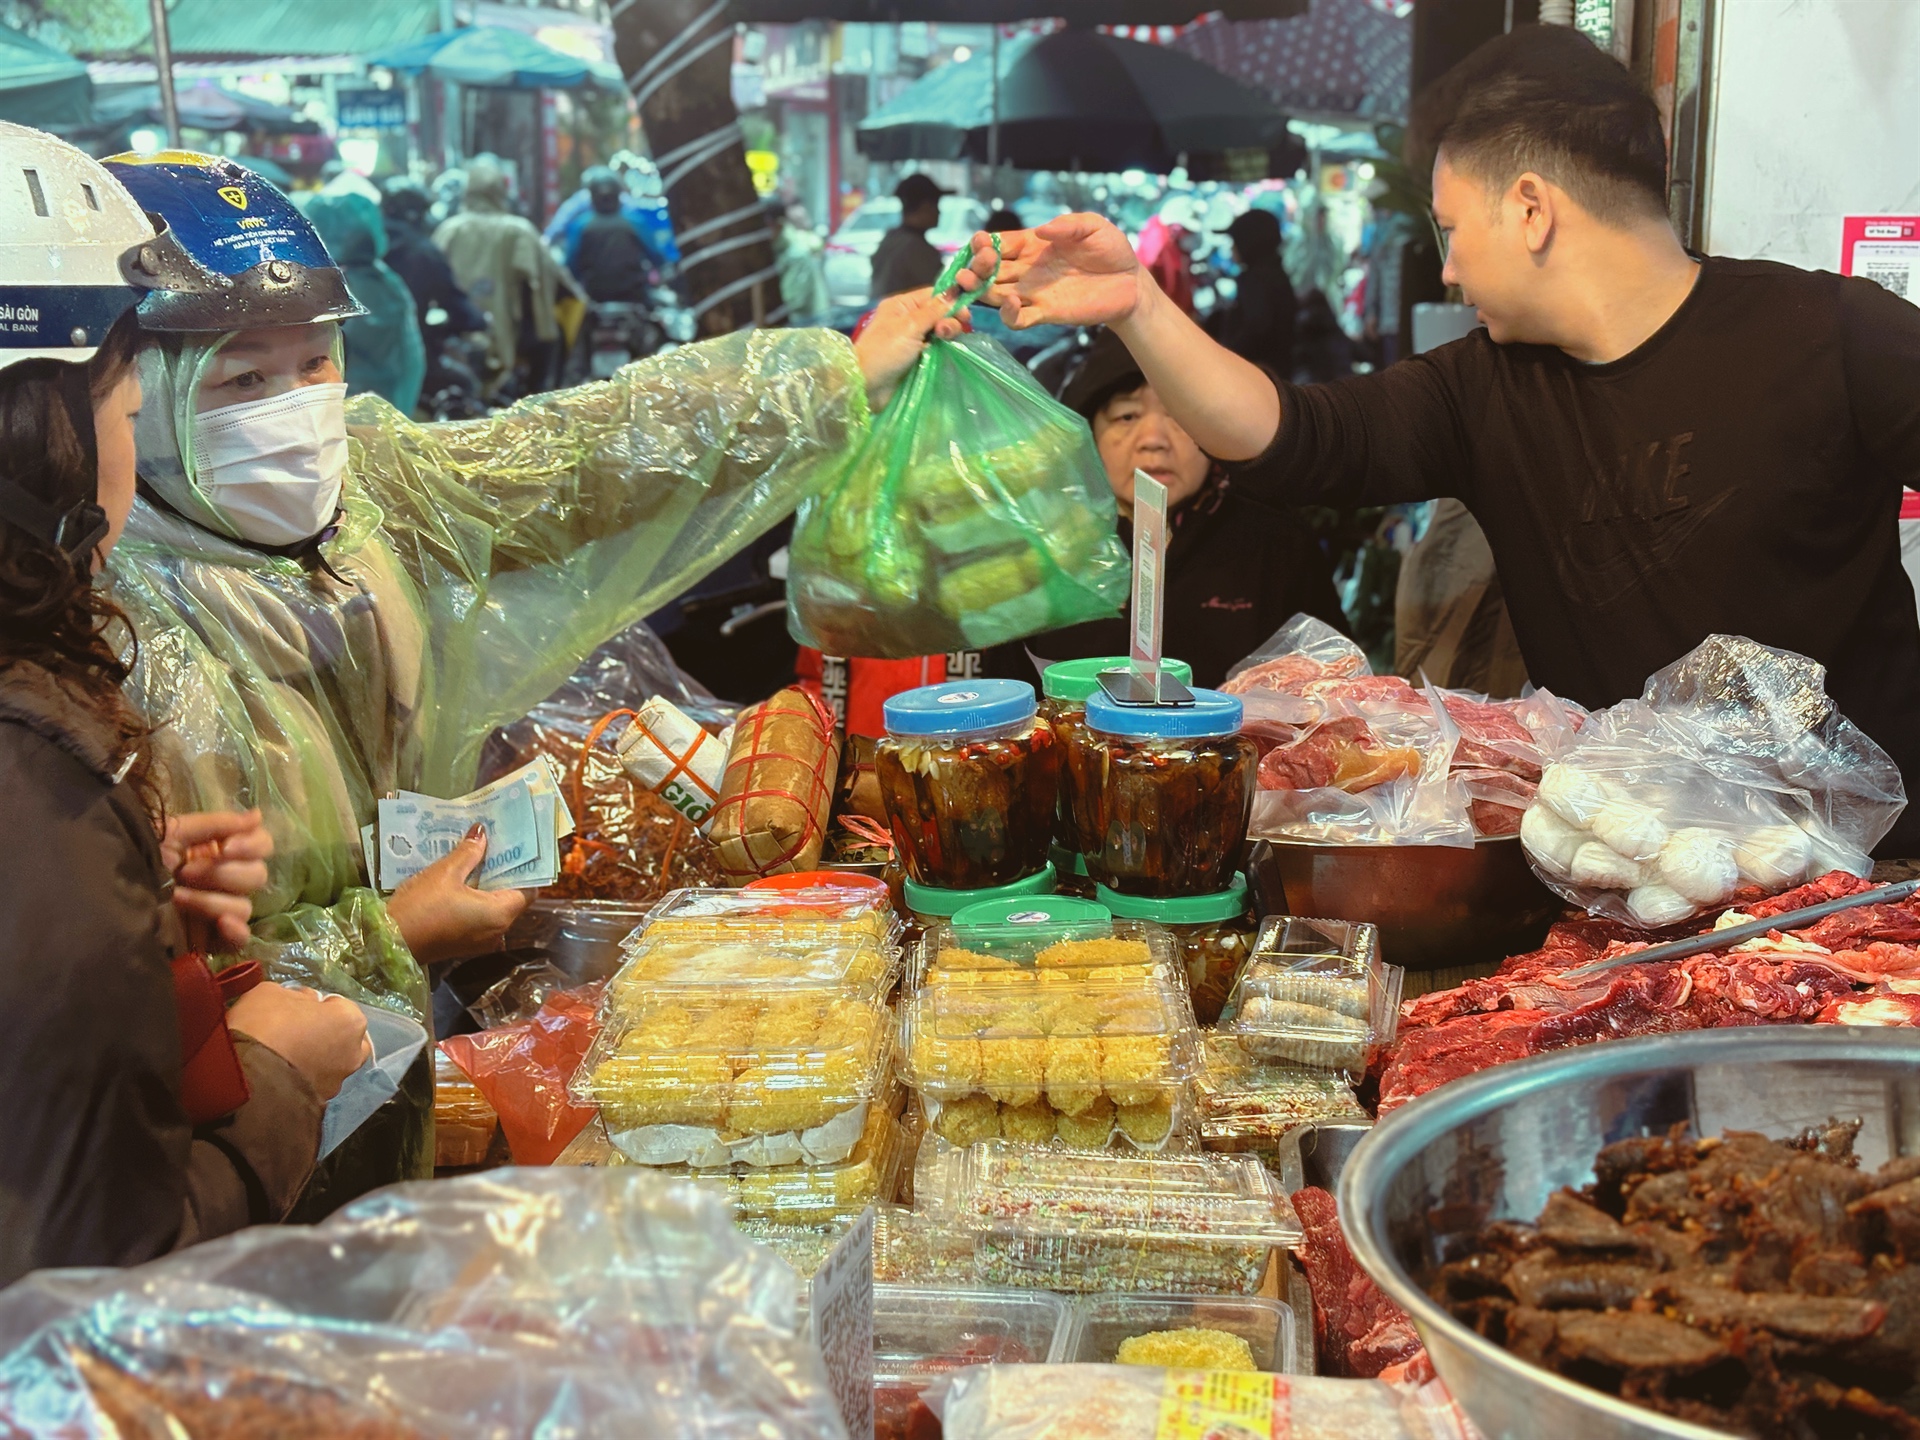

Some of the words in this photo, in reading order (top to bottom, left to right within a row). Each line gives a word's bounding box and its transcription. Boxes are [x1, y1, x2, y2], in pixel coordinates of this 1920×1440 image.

[236, 217, 268, 230] VNVC
[0, 303, 15, 320] SÀI
[16, 304, 39, 321] GÒN
[12, 323, 39, 333] BANK
[660, 781, 711, 823] GIÒ
